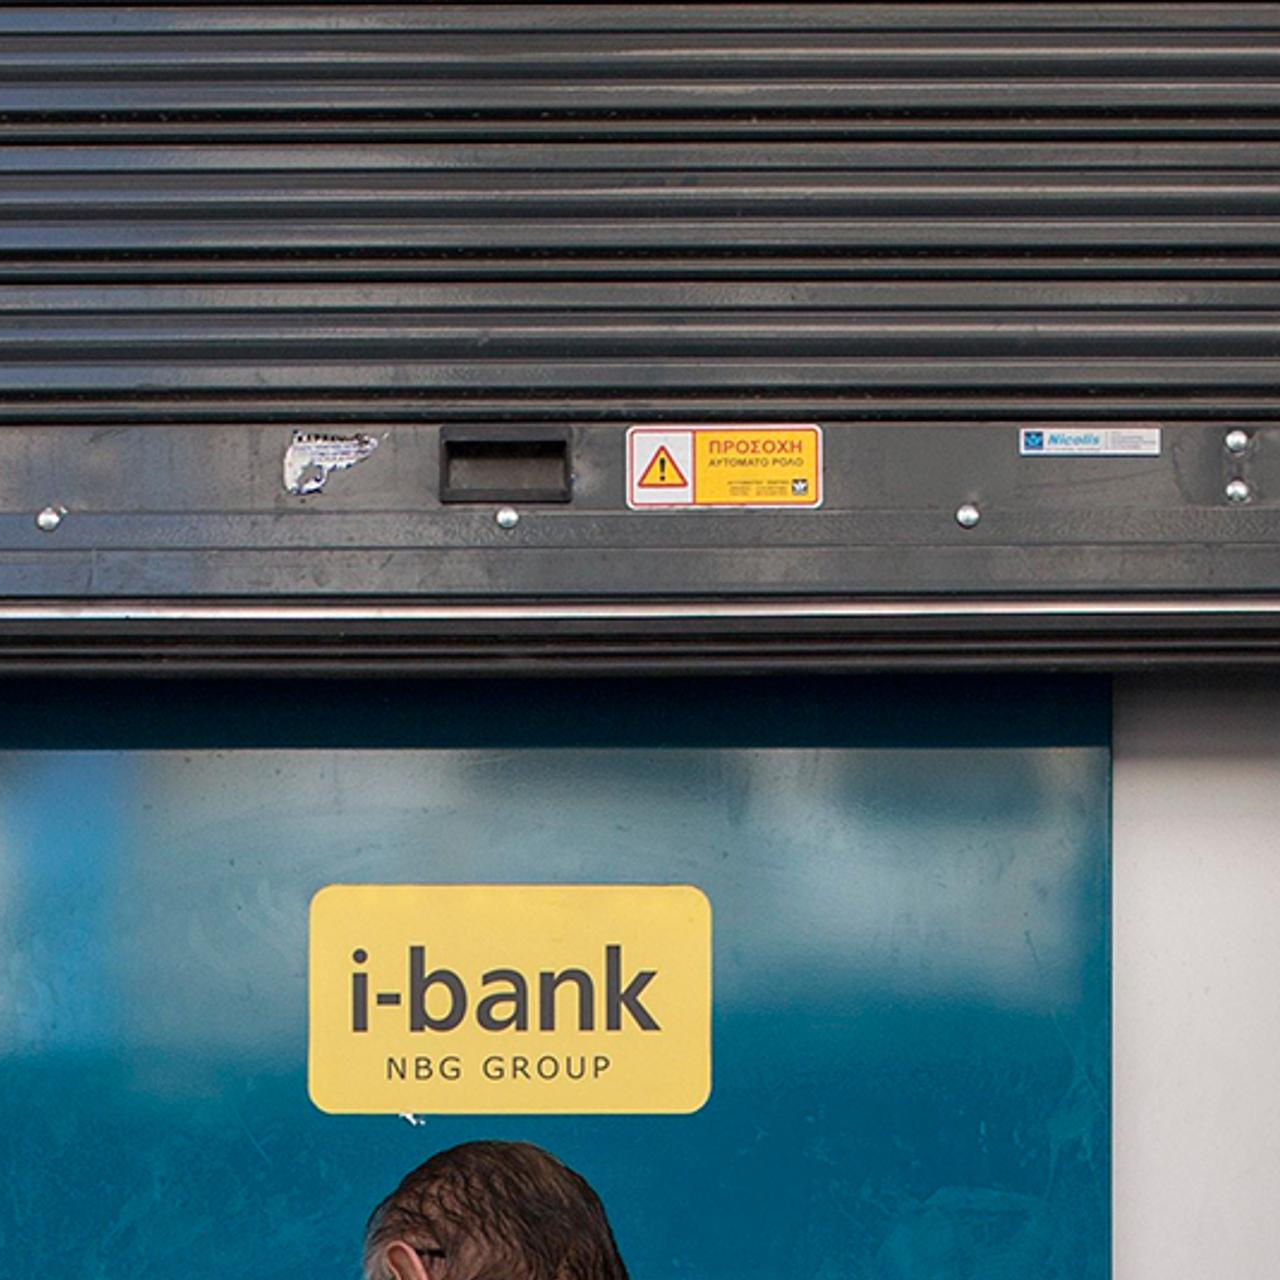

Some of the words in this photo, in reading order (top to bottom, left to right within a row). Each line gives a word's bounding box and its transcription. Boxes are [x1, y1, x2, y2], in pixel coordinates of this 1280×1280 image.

[708, 439, 803, 455] ΠΡΟΣΟΧΗ
[1047, 432, 1101, 446] Nicolis
[708, 456, 769, 468] ΑΥΤΟΜΑΤΟ
[772, 456, 805, 467] ΡΟΛΟ
[351, 944, 662, 1033] i-bank
[385, 1054, 462, 1081] NBG
[481, 1054, 612, 1081] GROUP
